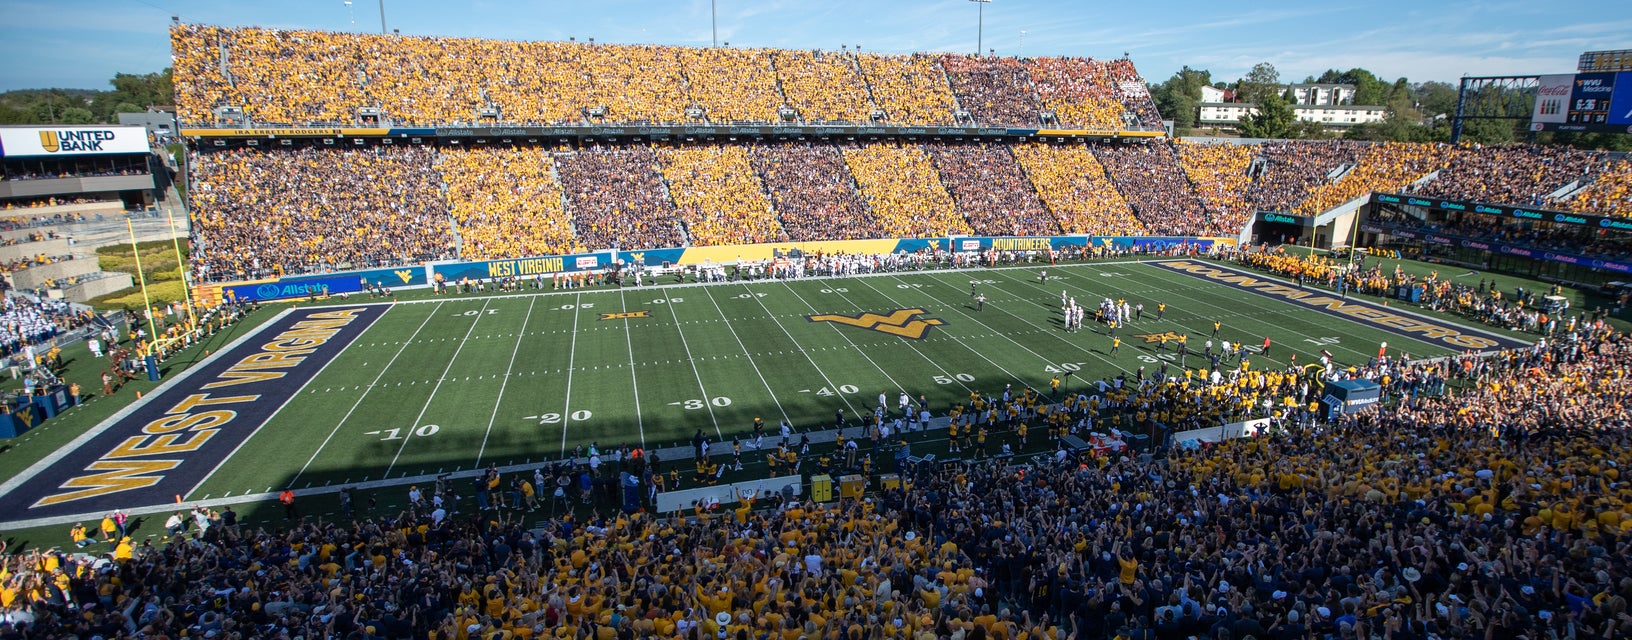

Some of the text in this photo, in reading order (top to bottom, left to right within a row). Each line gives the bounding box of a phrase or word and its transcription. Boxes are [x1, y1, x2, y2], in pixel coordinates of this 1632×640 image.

[1537, 84, 1571, 96] Coca-Cola
[58, 130, 115, 141] UNITED
[61, 141, 103, 151] BANK
[1274, 215, 1295, 224] Allstate
[992, 238, 1051, 250] MOUNTAINEERS
[488, 256, 564, 277] WEST VIRGINIA
[1160, 261, 1500, 349] MOUNTAINEERS
[1137, 354, 1176, 363] 30
[1044, 362, 1080, 374] 40
[932, 373, 976, 386] 50
[816, 384, 860, 398] 40
[28, 307, 368, 509] WEST VIRGINIA
[684, 396, 732, 410] 30
[540, 409, 593, 424] 20
[380, 424, 440, 441] 10
